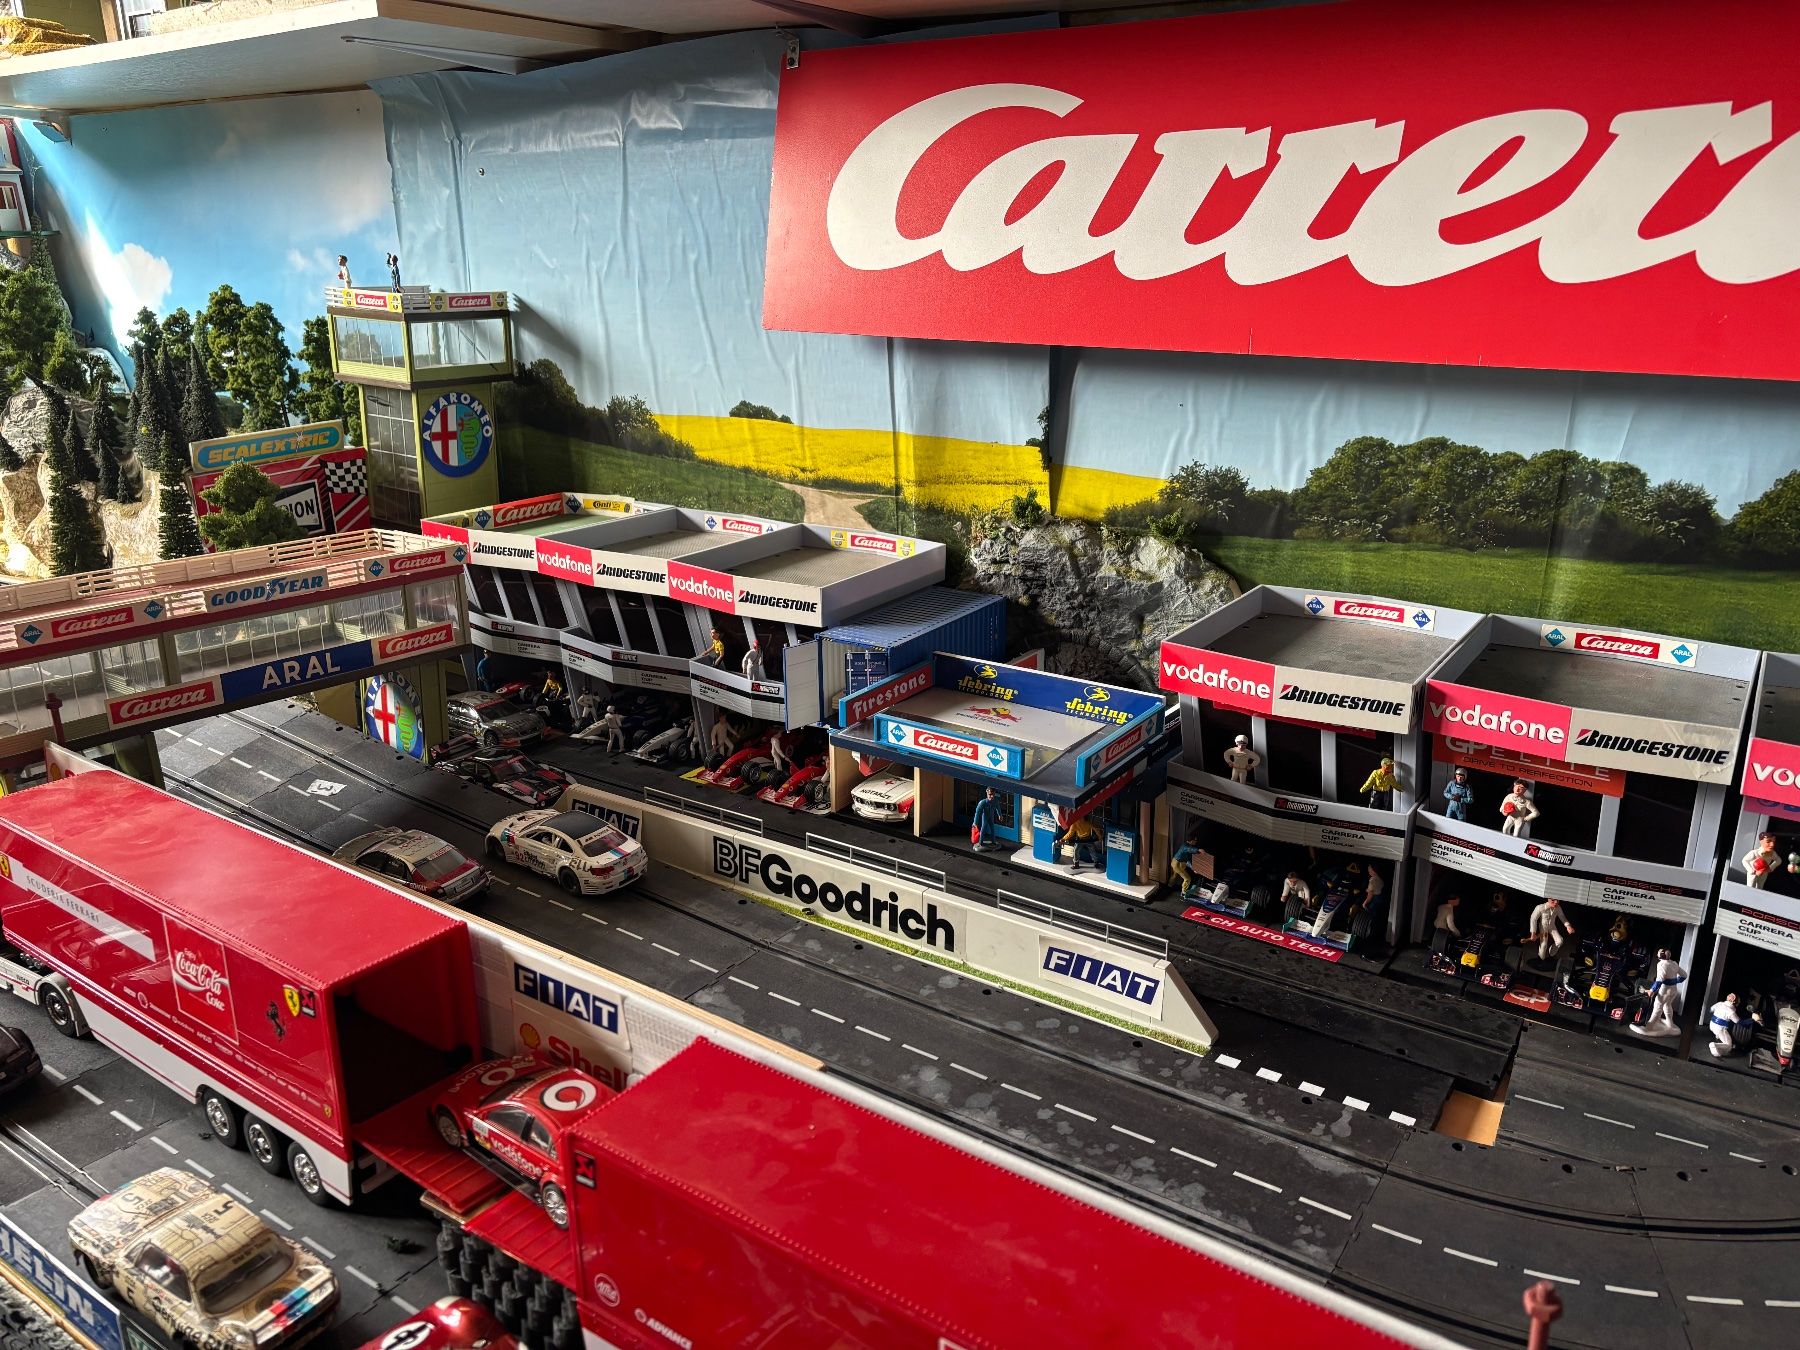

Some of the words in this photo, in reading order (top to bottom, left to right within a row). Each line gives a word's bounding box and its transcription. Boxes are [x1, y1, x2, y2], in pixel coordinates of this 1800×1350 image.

[356, 294, 385, 306] Carrera
[451, 297, 488, 306] Carrera
[208, 431, 331, 464] SCALEXTRIC
[495, 498, 563, 524] Carrera
[725, 520, 760, 533] Carrera
[473, 541, 535, 560] BRIDGESTONE
[854, 536, 895, 551] Carrera
[392, 553, 443, 571] Carrera
[537, 552, 592, 576] vodafone
[596, 563, 666, 584] BRIDGESTONE
[669, 575, 733, 603] vodafone
[146, 605, 163, 613] ARAL
[738, 590, 818, 613] BRIDGESTONE
[1339, 602, 1400, 620] Carrera
[58, 611, 129, 635] Carrera
[1413, 616, 1431, 624] ARAL
[23, 629, 41, 638] ARAL
[385, 629, 448, 655] Carrera
[1546, 632, 1565, 641] ARAL
[1580, 633, 1654, 656] Carrera
[1673, 648, 1693, 658] ARAL
[262, 652, 341, 690] ARAL
[1162, 661, 1271, 699] vodafone
[119, 686, 208, 719] Carrera
[852, 671, 927, 718] Firestone
[1279, 683, 1406, 716] BRIDGESTONE
[1428, 700, 1565, 744] vodafone
[918, 733, 974, 756] Carrera
[1107, 729, 1141, 759] Carrera
[1574, 728, 1730, 765] BRIDGESTONE
[988, 752, 1003, 760] ARAL
[1463, 756, 1499, 769] DRIVE
[1501, 763, 1516, 772] TO
[1519, 767, 1593, 788] PERFECTION
[1180, 791, 1215, 806] CARRERA
[1180, 796, 1196, 804] CUP
[1321, 828, 1365, 840] CARRERA
[1432, 831, 1496, 856] PORSCHE
[1430, 848, 1450, 858] CUP
[1431, 842, 1474, 860] CARRERA
[712, 836, 956, 952] BFGoodrich
[1603, 887, 1656, 901] CARRERA
[1604, 876, 1683, 895] PORSCHE
[26, 875, 64, 904] SCUDERIA
[66, 898, 99, 923] FERRARI
[1602, 893, 1626, 901] CUP
[1191, 911, 1234, 926] FACH
[1236, 924, 1285, 942] AUTO
[1289, 938, 1336, 957] TECH
[1738, 925, 1762, 935] CUP
[1739, 918, 1794, 939] CARRERA
[1046, 950, 1159, 1003] FIAT
[518, 968, 615, 1028] FIAT
